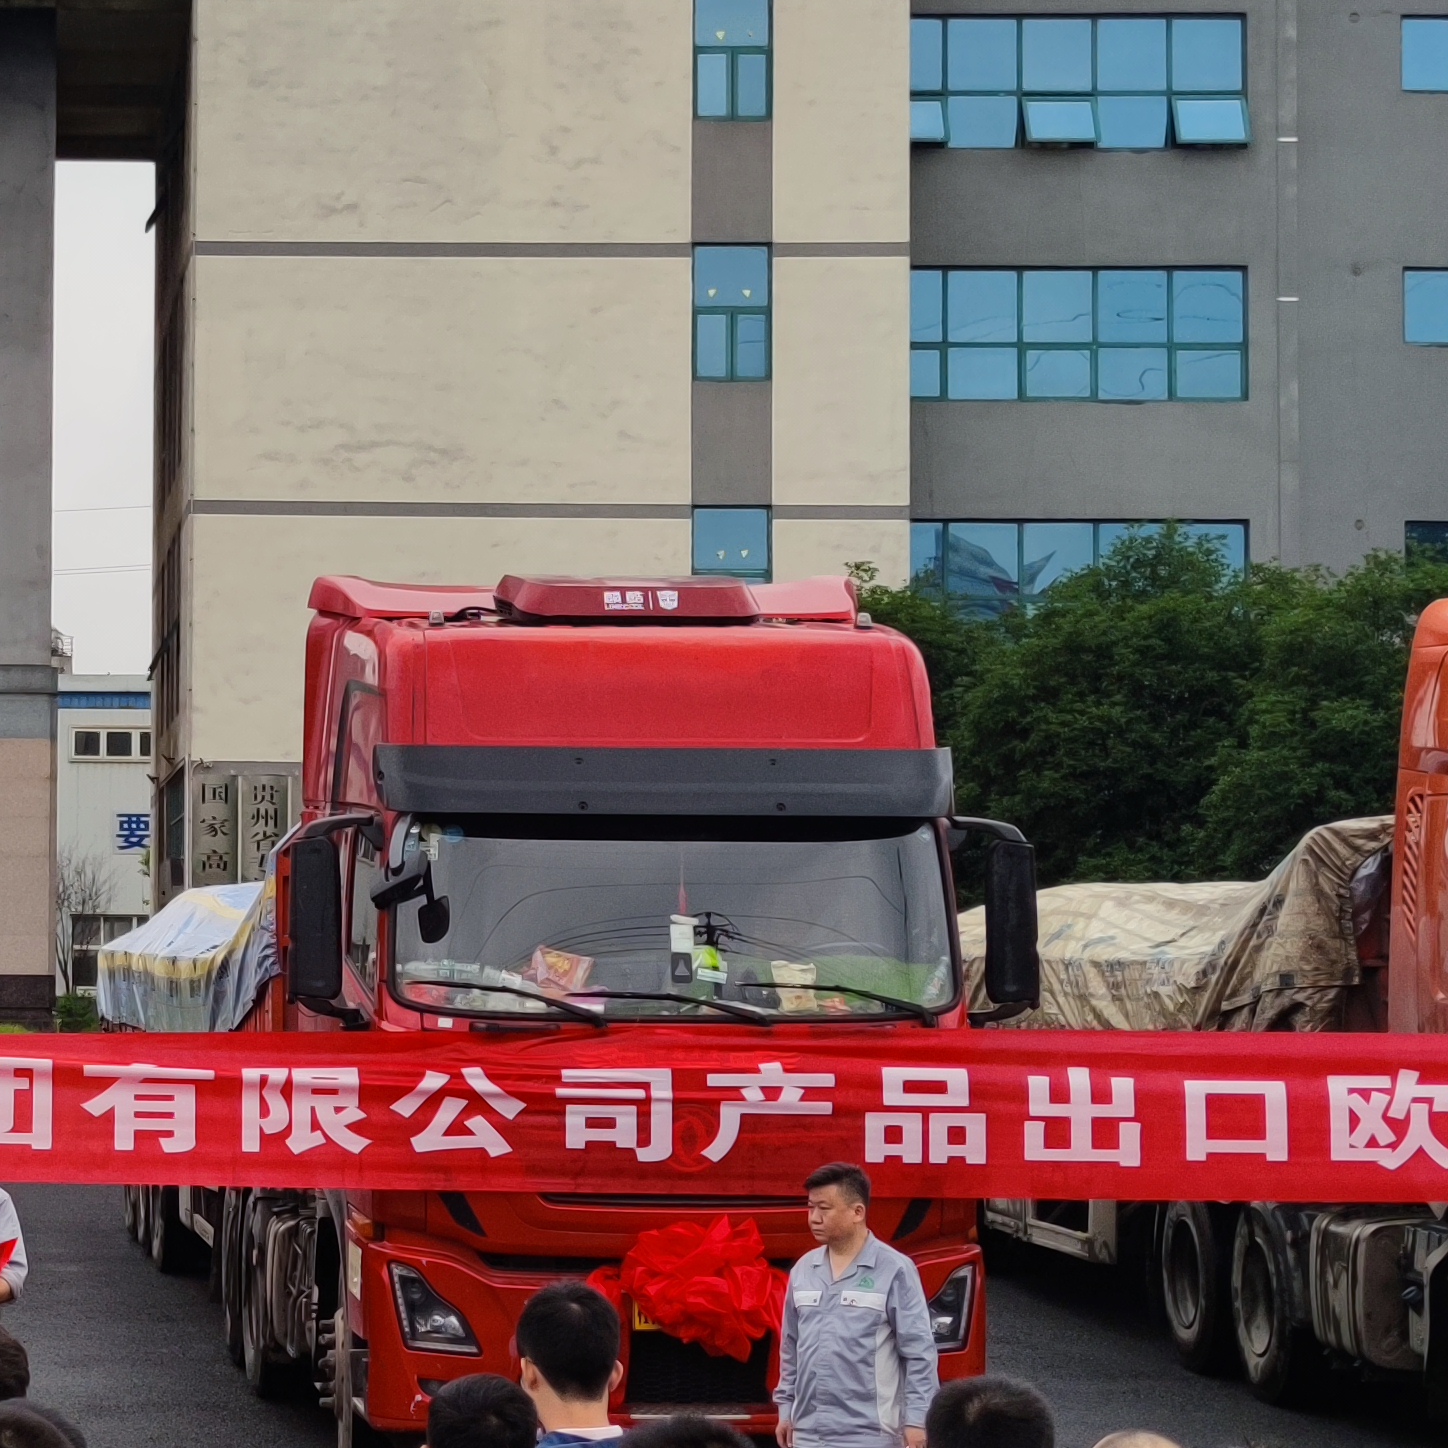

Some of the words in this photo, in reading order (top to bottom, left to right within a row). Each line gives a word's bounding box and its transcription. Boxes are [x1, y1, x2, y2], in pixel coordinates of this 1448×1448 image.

[115, 813, 151, 850] 要
[200, 783, 230, 871] 国家高
